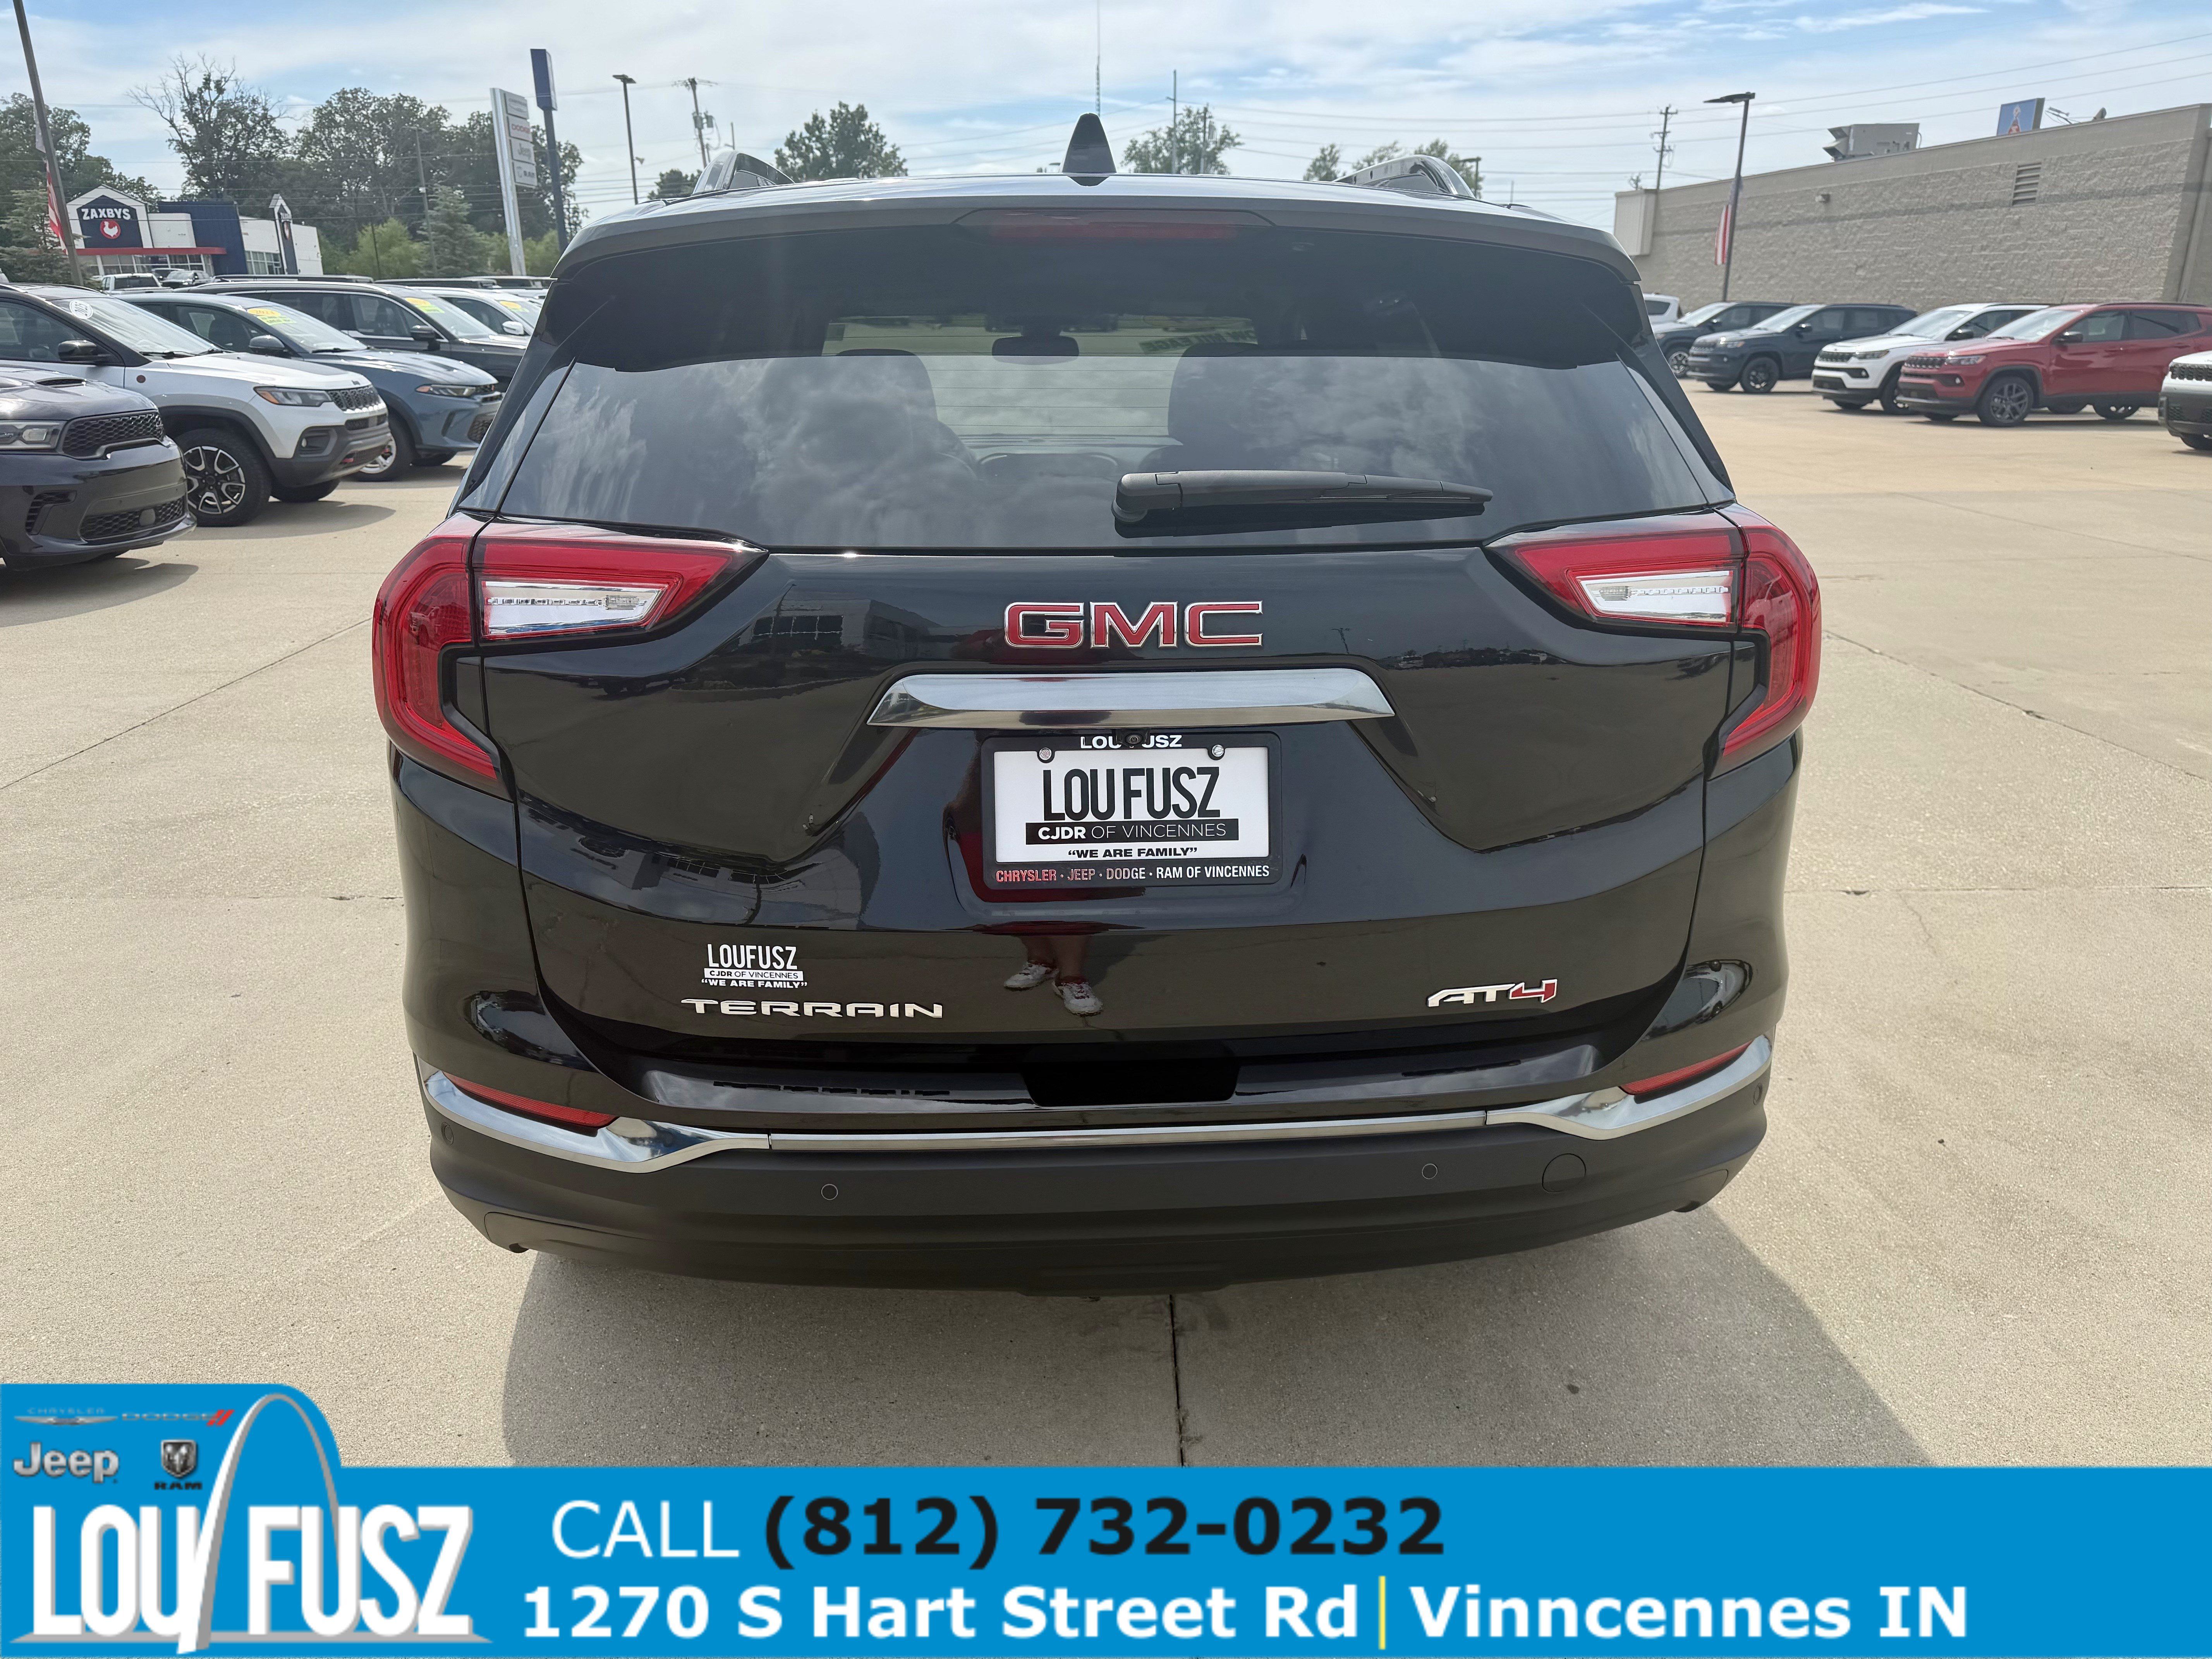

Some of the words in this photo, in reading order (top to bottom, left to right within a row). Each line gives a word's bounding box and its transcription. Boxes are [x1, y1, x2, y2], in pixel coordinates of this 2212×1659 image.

[81, 208, 131, 220] ZAXBYS
[1005, 601, 1263, 648] GMC
[1043, 768, 1115, 821] LOU
[1122, 766, 1220, 819] FUSZ
[1038, 826, 1086, 840] CJDR
[1091, 826, 1116, 839] OF
[1122, 823, 1226, 838] VINCENNES
[1102, 848, 1133, 858] ARE
[996, 869, 1056, 882] CHRYSLER
[1067, 869, 1096, 881] JEEP
[1106, 867, 1146, 880] DODGE
[1156, 866, 1182, 879] RAM
[1186, 866, 1201, 878] OF
[1204, 865, 1269, 878] VINCENNES
[1428, 979, 1558, 1007] AT4
[681, 998, 943, 1018] TERRAIN
